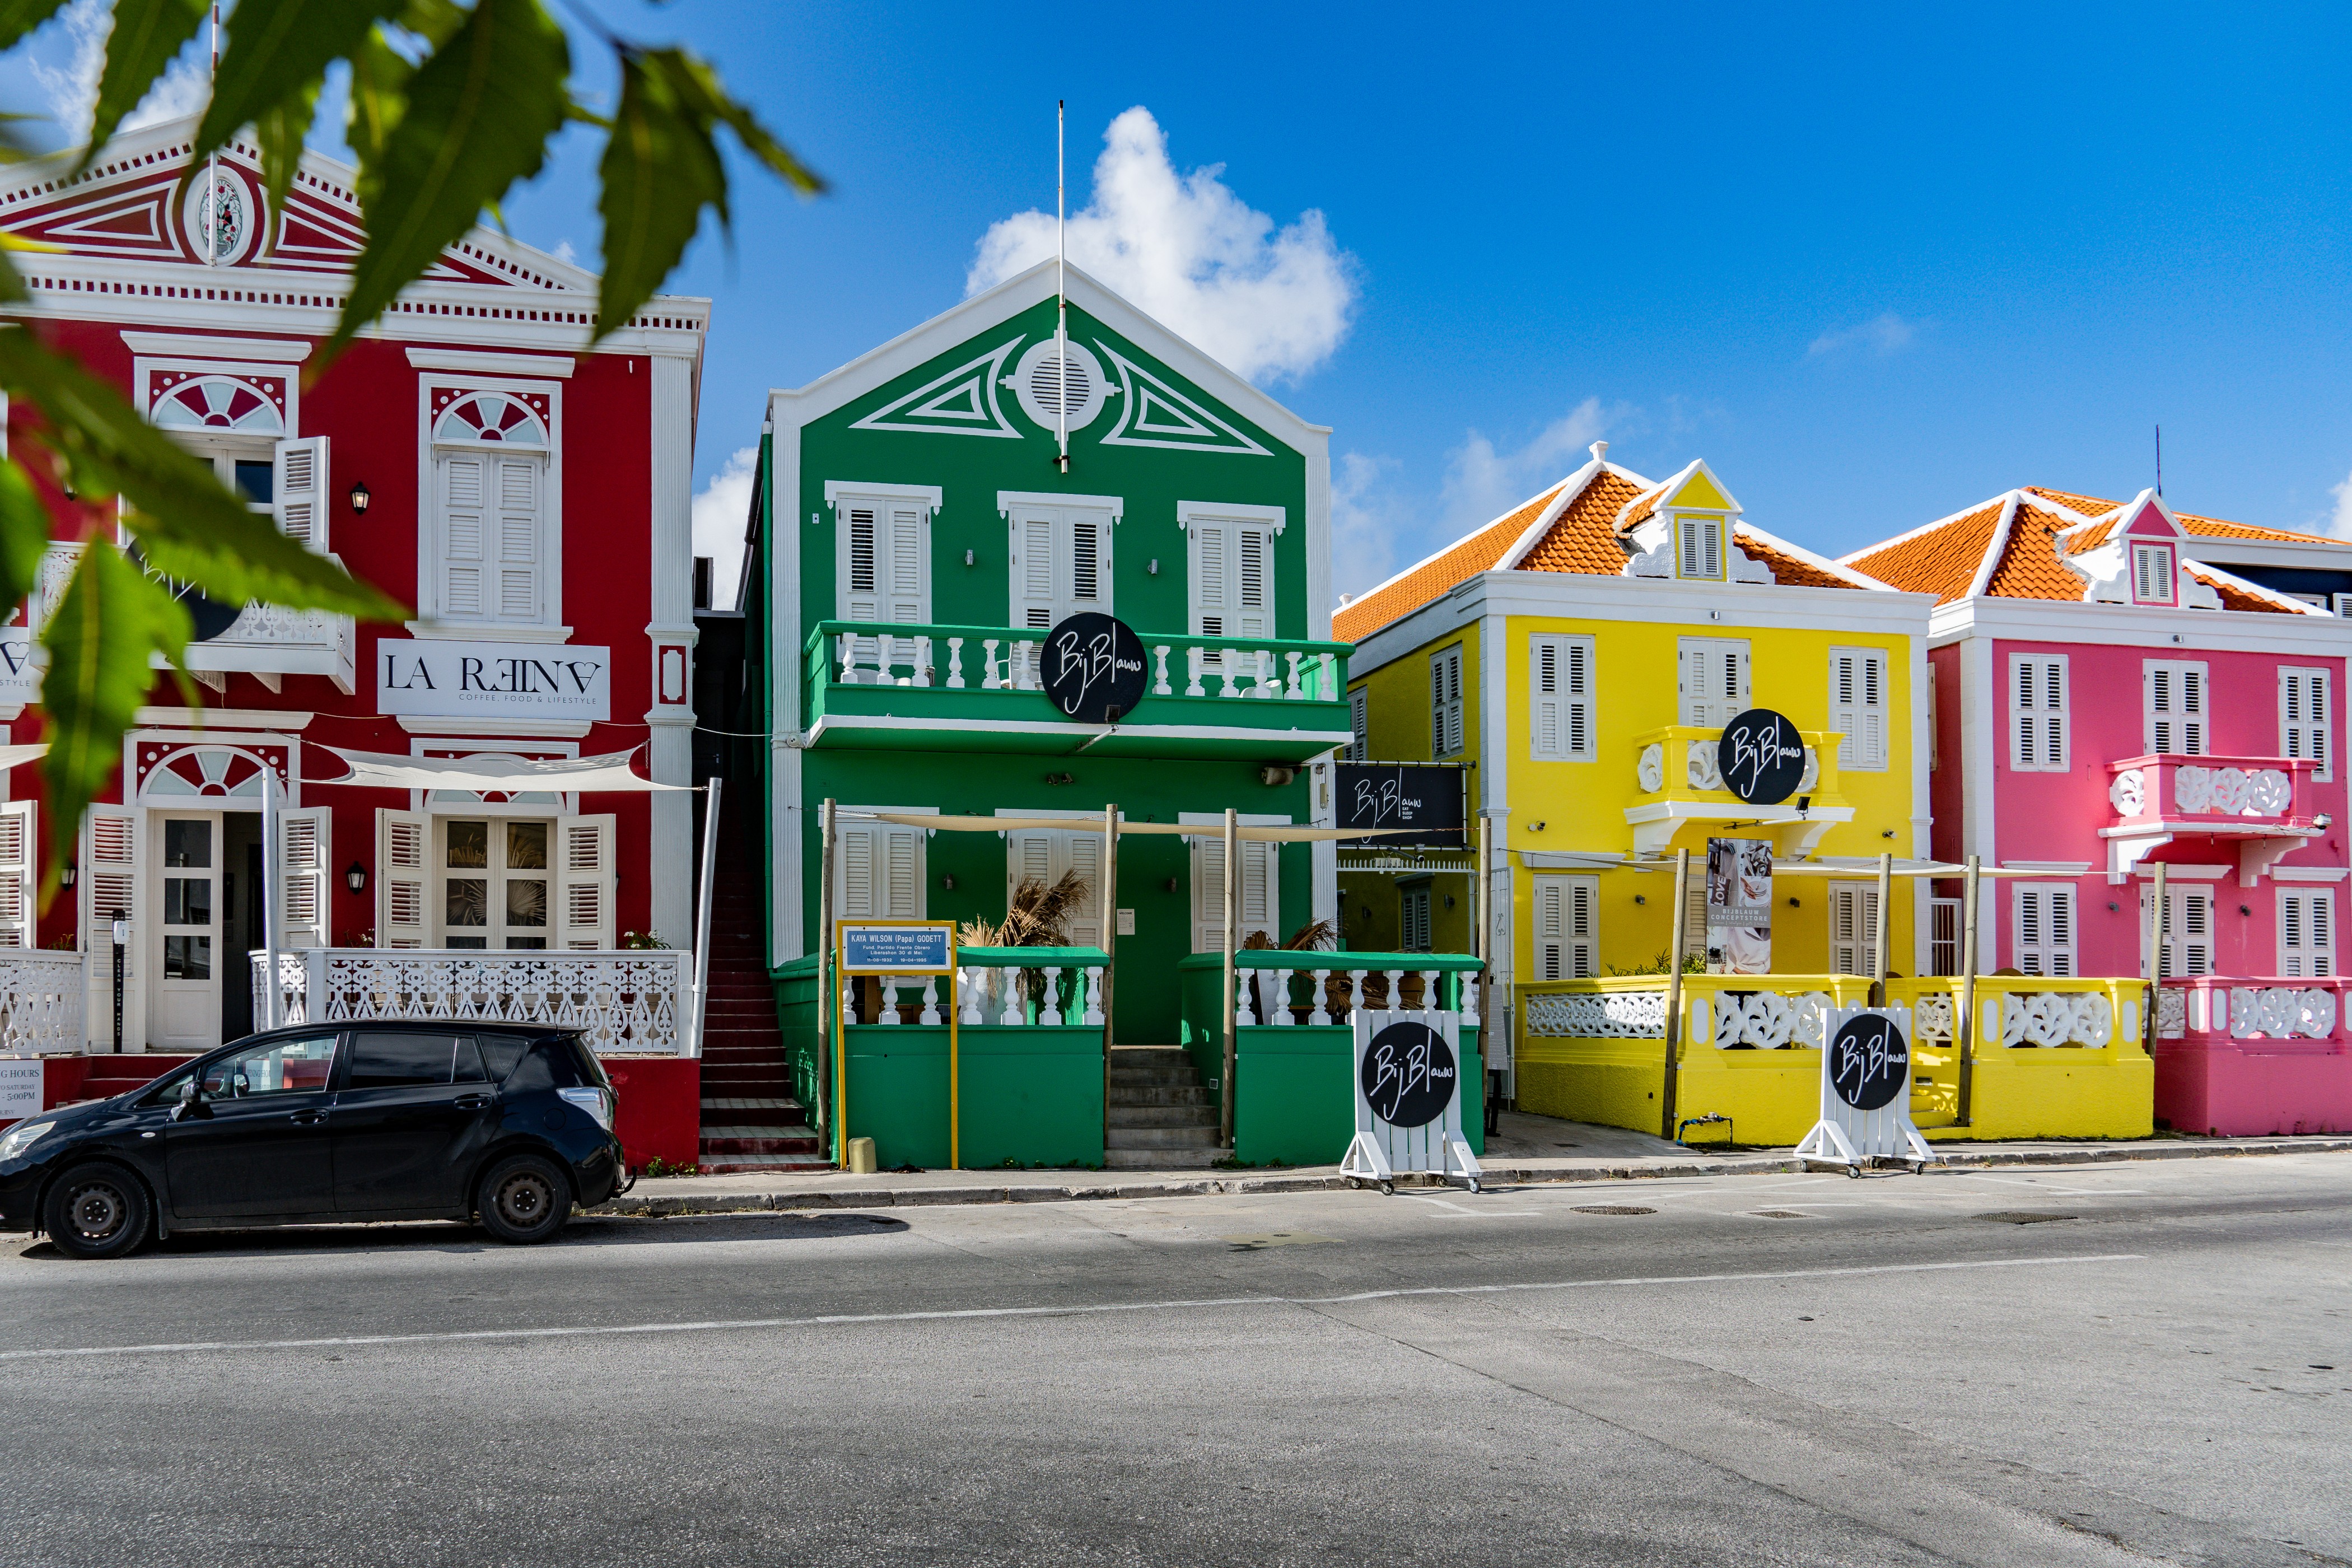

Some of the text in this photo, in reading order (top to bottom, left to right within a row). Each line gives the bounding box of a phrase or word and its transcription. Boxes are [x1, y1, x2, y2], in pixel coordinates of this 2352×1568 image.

[385, 655, 437, 689] LA
[459, 694, 500, 702] COFFEE,
[1714, 876, 1726, 906] LOVE
[895, 934, 914, 944] (Papa)
[10, 1069, 40, 1078] HOURS
[7, 1092, 35, 1101] 5:00PM
